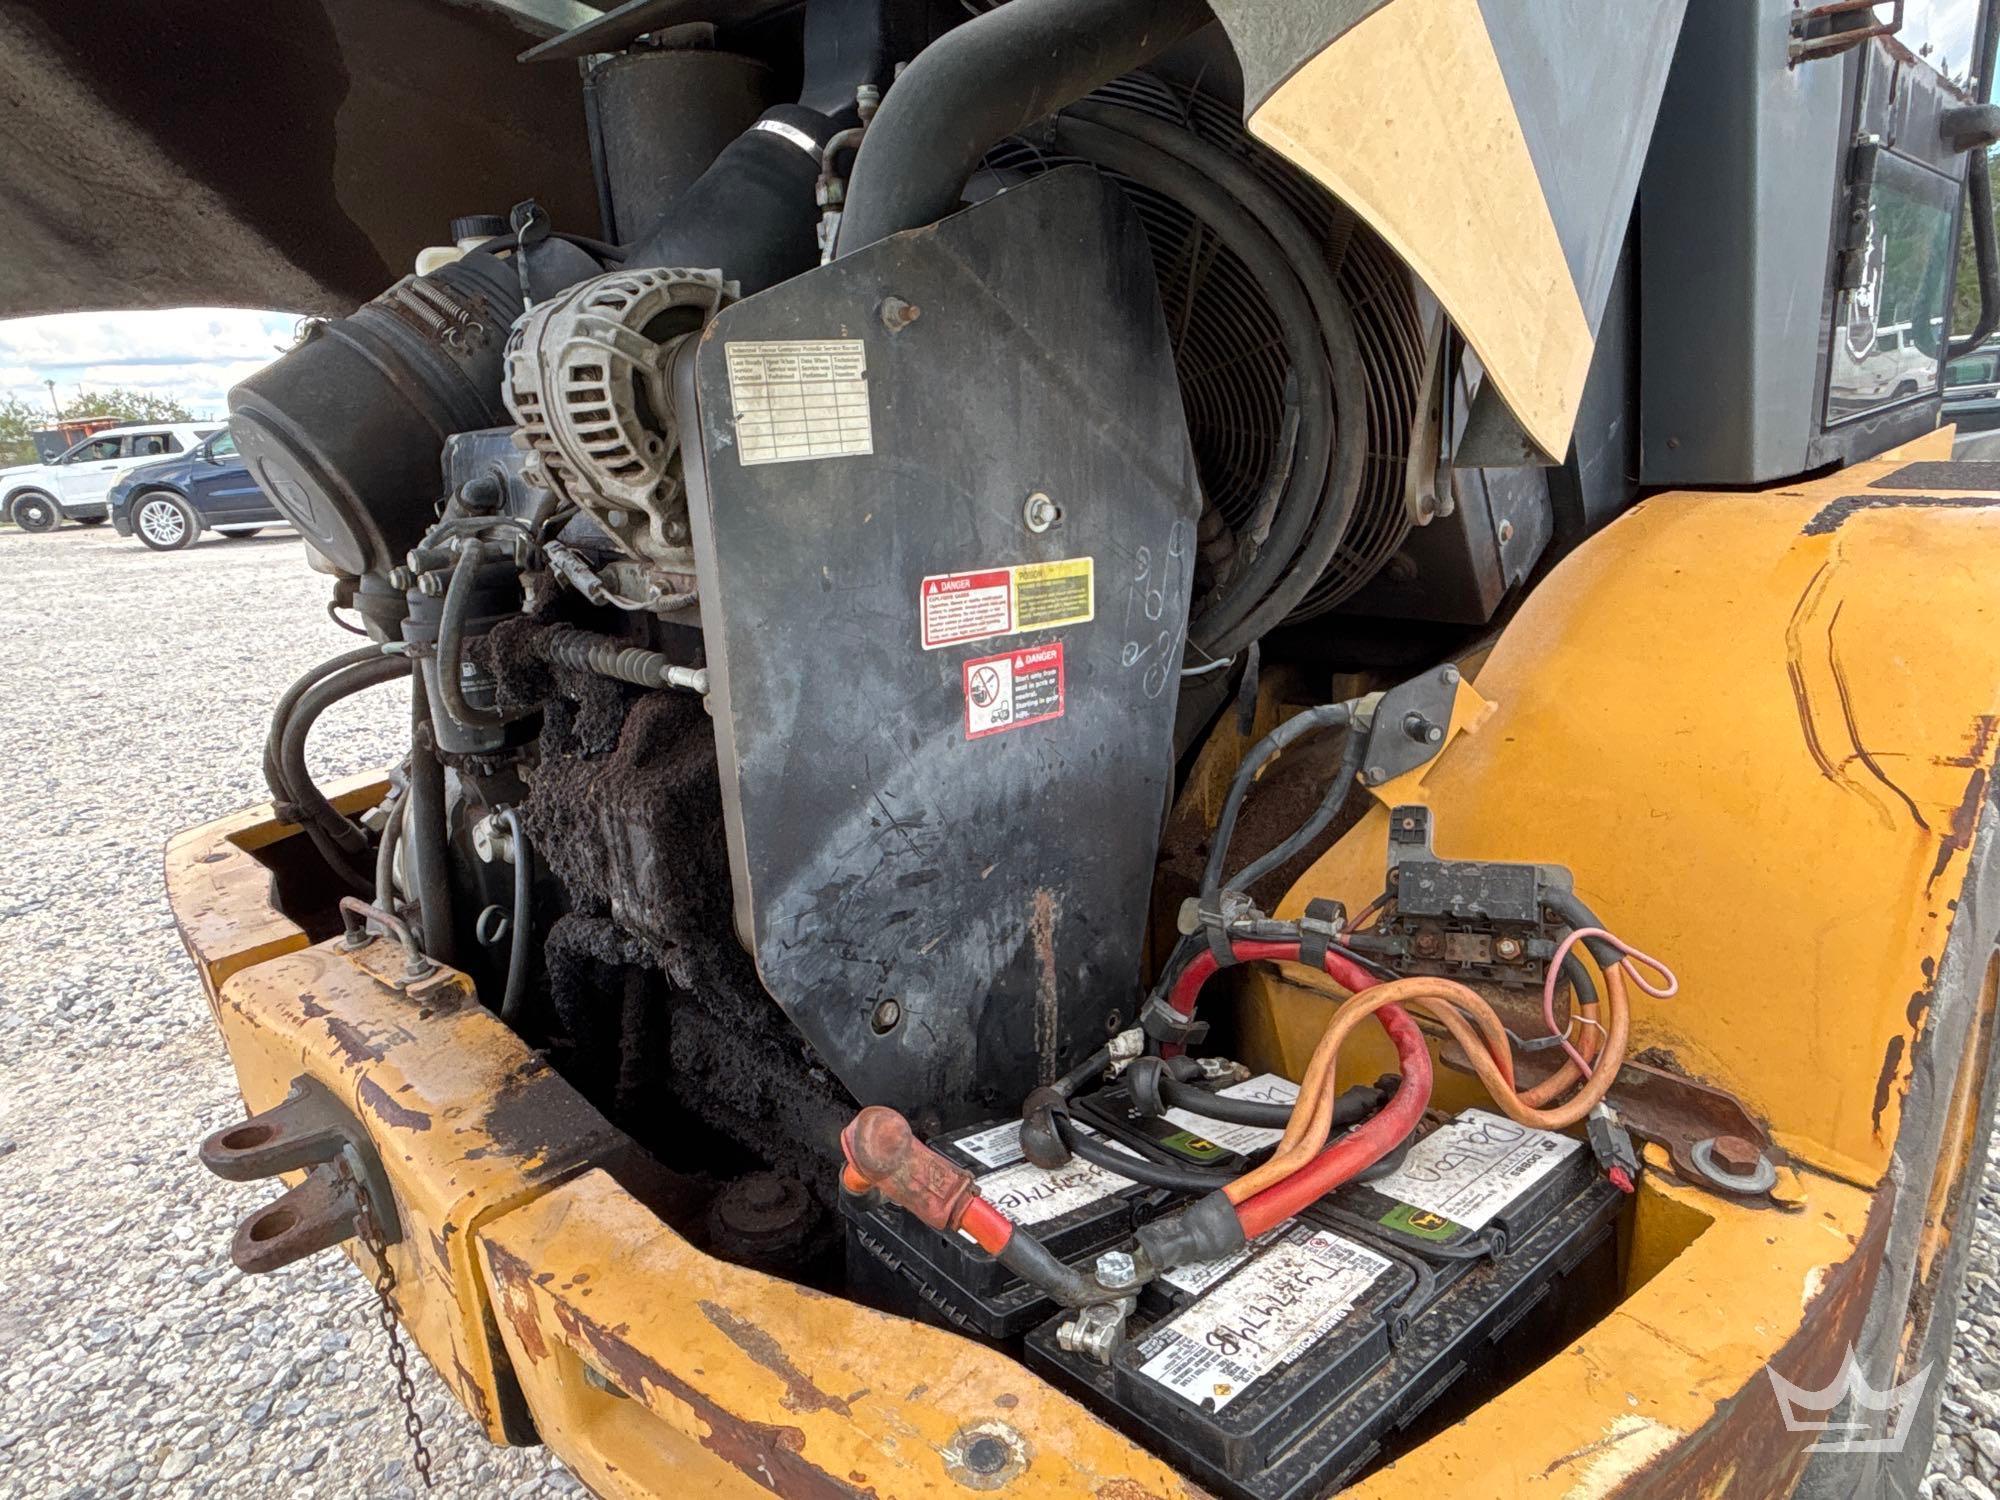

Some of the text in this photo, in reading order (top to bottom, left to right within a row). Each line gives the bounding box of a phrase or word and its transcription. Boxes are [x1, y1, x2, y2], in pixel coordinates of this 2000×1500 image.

[940, 579, 971, 592] DANGER
[1025, 650, 1057, 665] DANGER
[1404, 1123, 1526, 1182] Dalton
[1510, 1153, 1543, 1177] DOBBS
